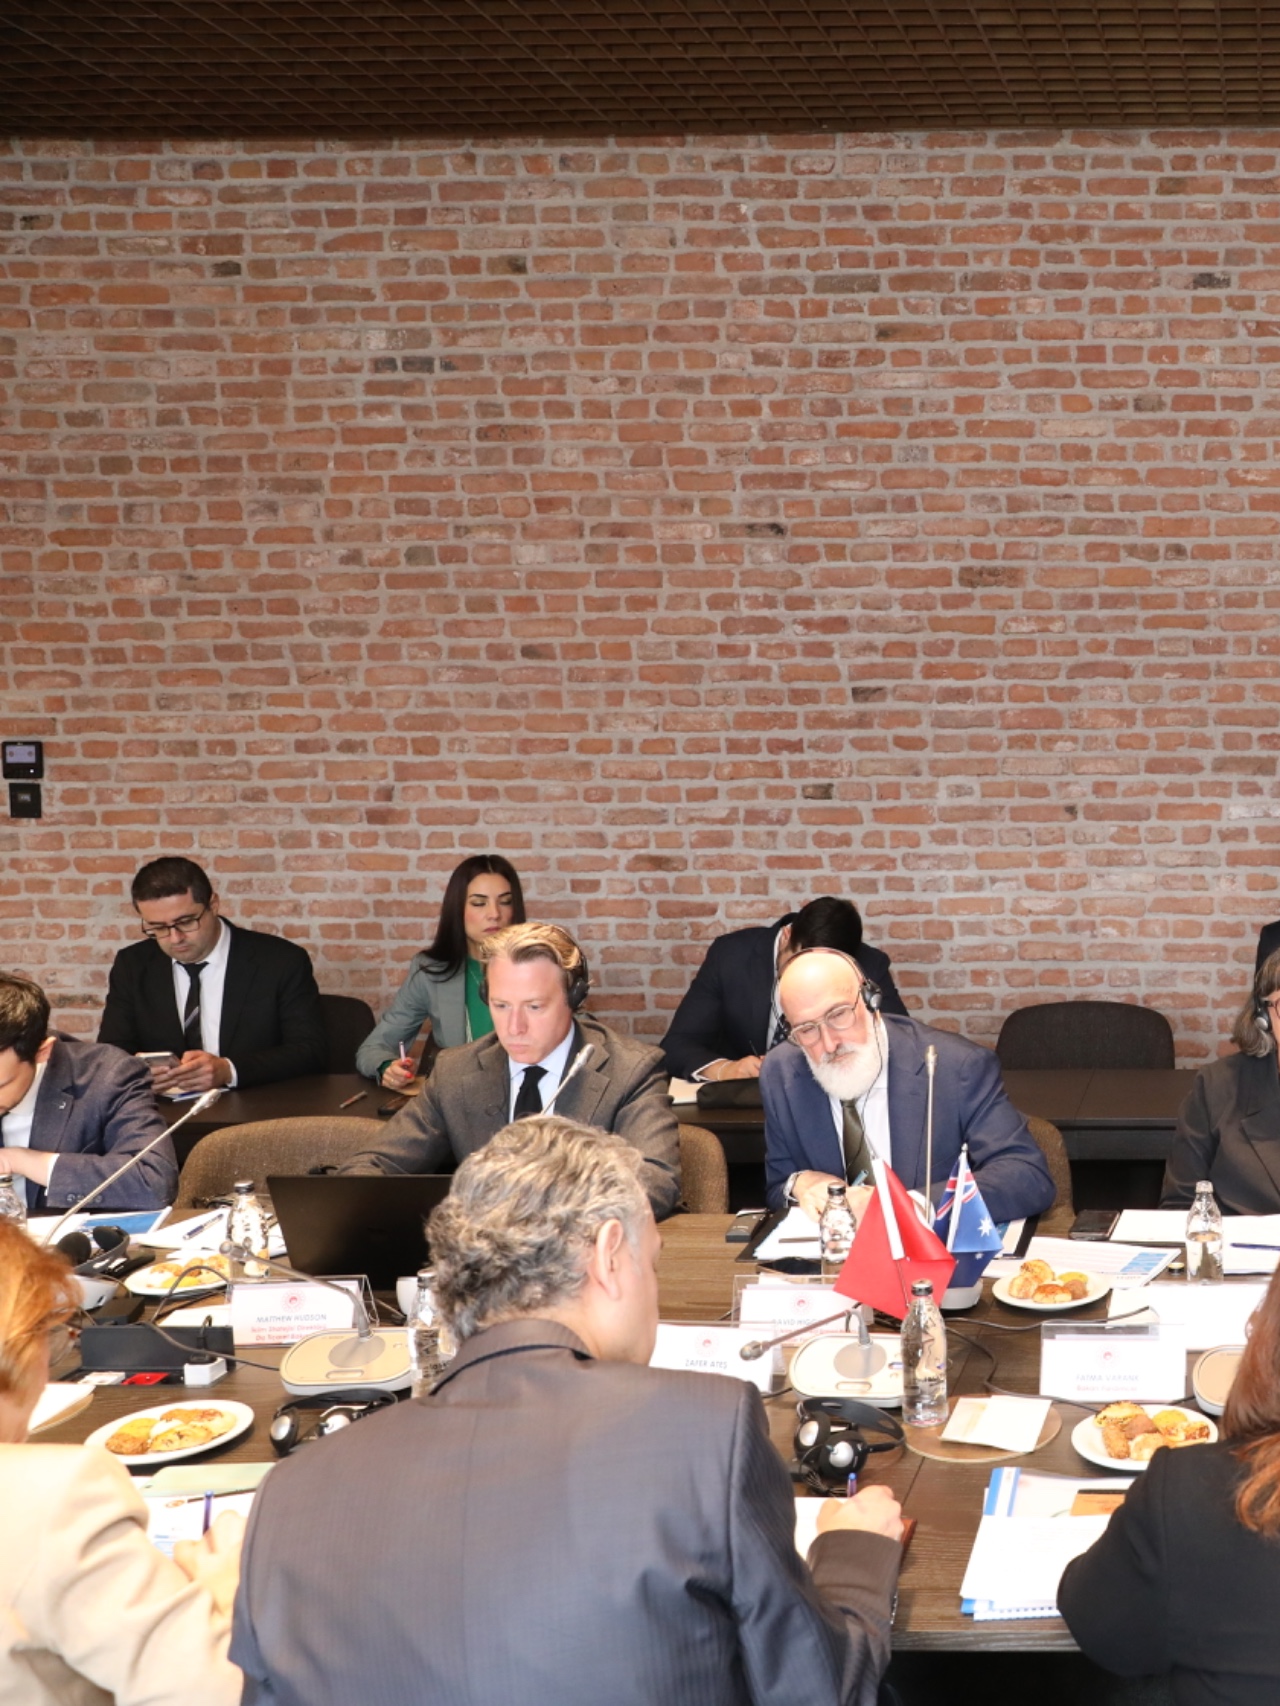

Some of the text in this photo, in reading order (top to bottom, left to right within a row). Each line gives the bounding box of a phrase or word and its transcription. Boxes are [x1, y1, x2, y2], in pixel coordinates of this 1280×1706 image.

[256, 1314, 327, 1323] MATTHEW HUDSON
[685, 1359, 708, 1367] ZAFER
